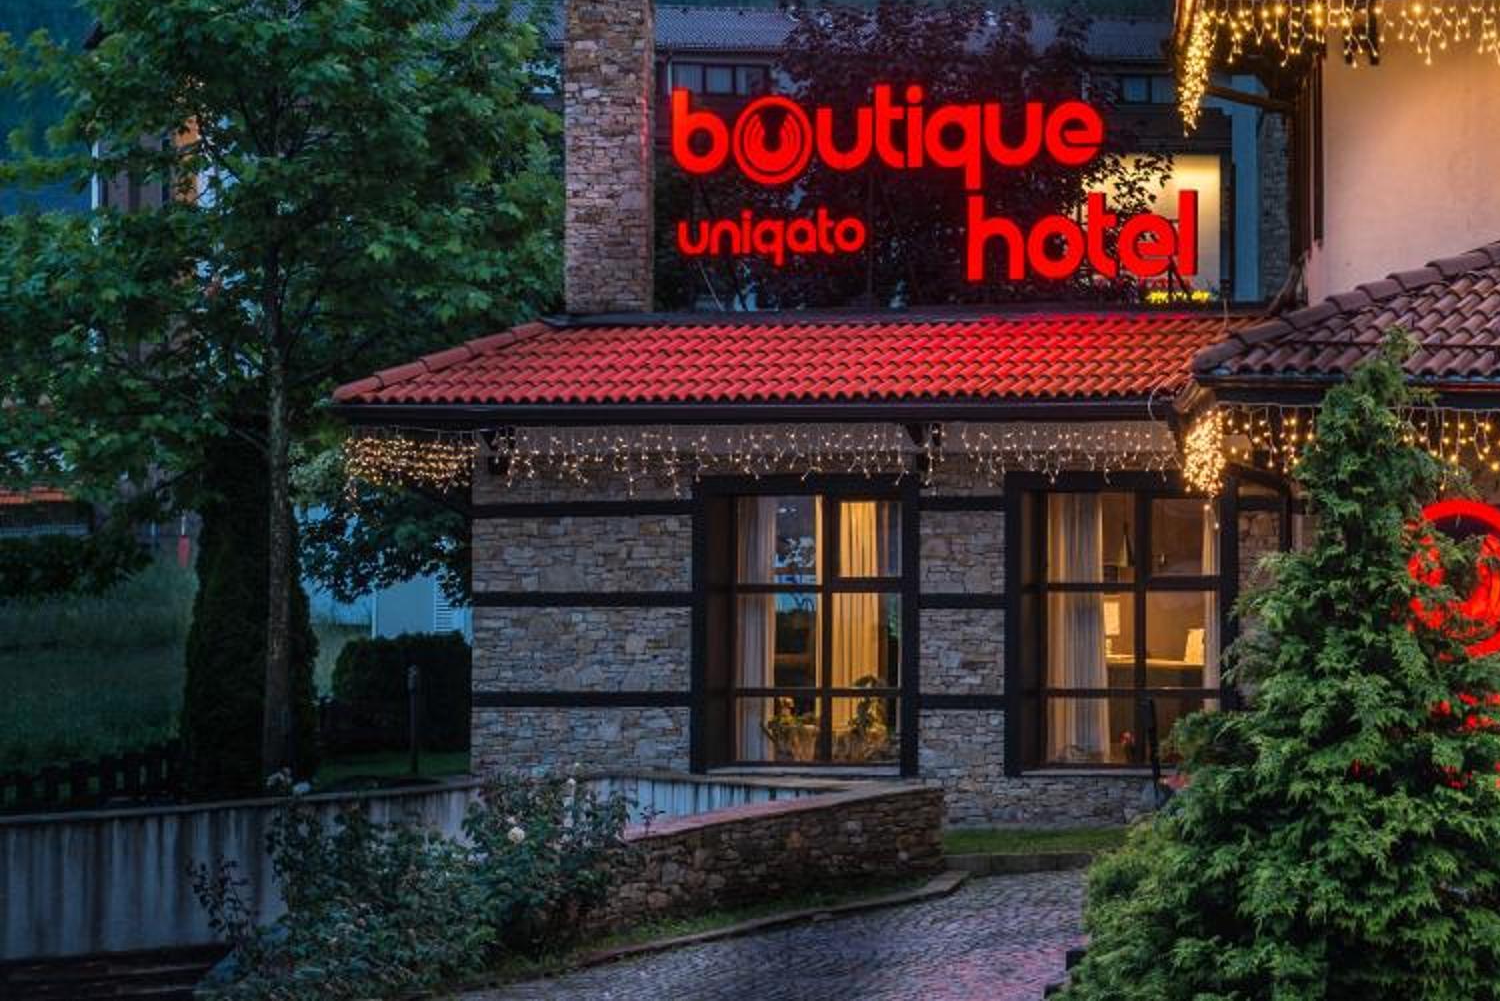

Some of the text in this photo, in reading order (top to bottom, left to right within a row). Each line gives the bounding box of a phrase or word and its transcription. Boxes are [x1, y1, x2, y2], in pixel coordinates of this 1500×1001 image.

[672, 83, 1104, 190] boutique
[677, 208, 866, 266] uniqato
[967, 190, 1198, 281] hotel
